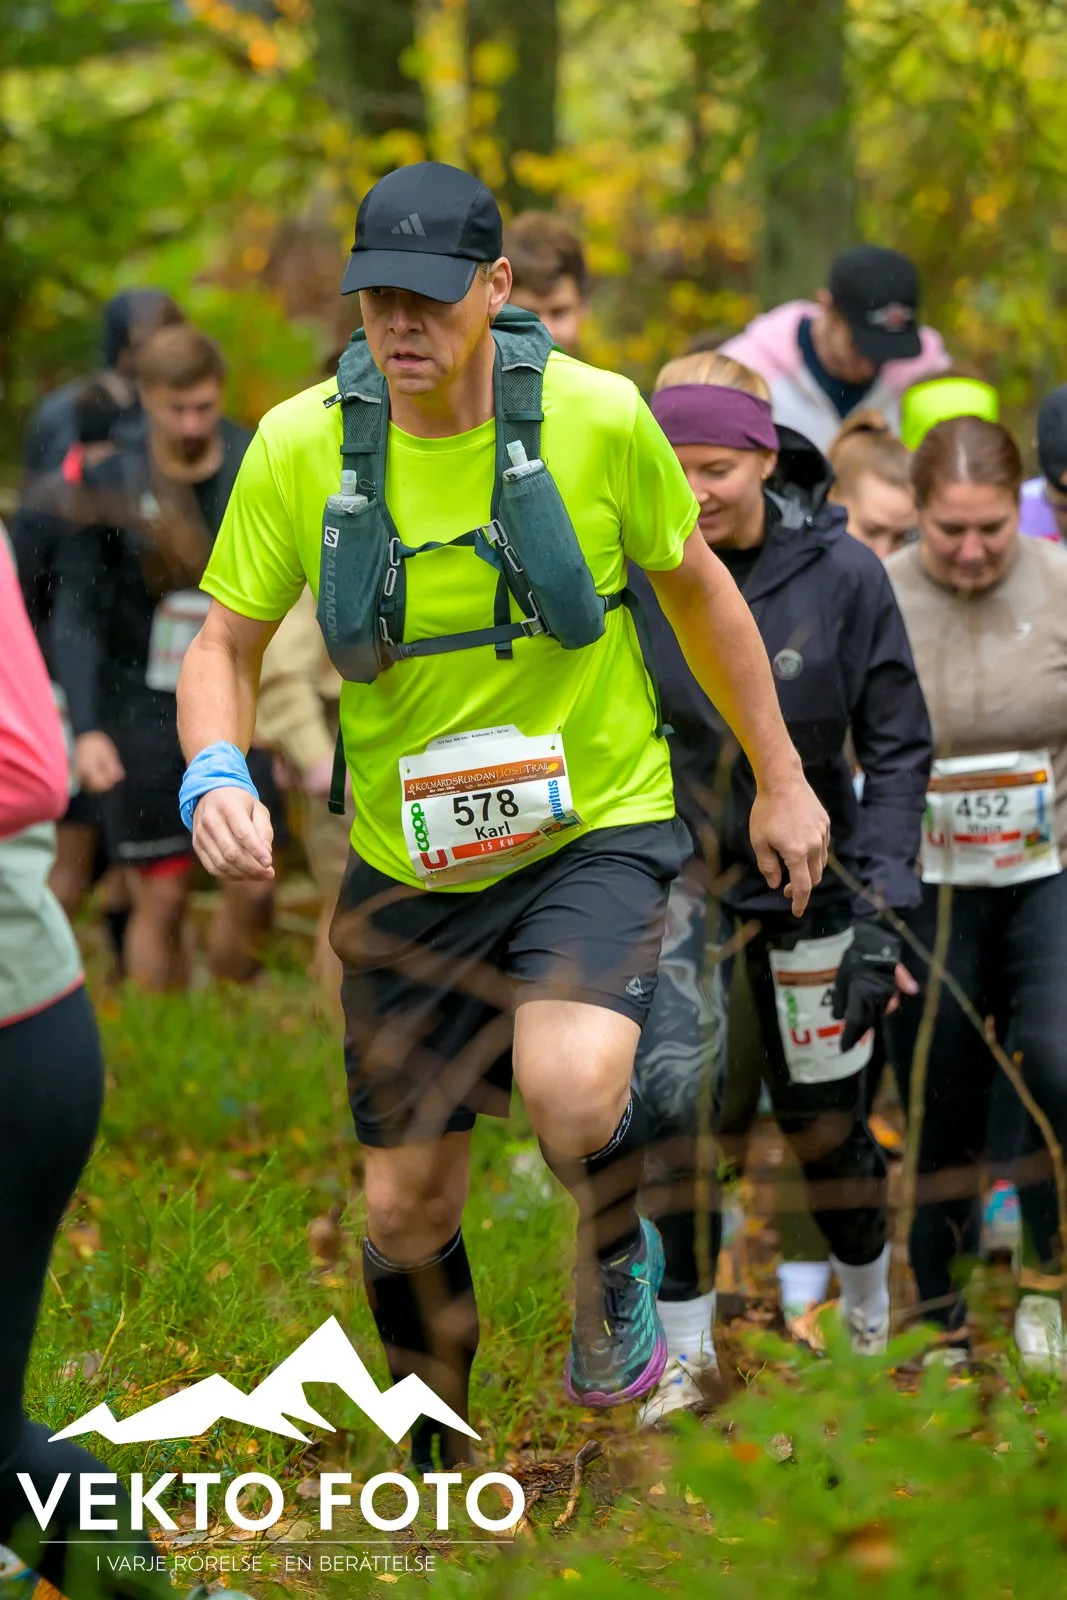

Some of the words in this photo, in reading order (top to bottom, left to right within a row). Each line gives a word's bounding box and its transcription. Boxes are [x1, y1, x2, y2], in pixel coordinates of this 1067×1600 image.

[324, 547, 339, 642] SALOMON
[524, 762, 550, 774] TRAIL
[453, 789, 519, 826] 578
[956, 793, 1010, 819] 452
[410, 802, 430, 852] coop
[475, 821, 511, 840] Karl
[480, 842, 493, 852] 15
[500, 838, 514, 848] KM
